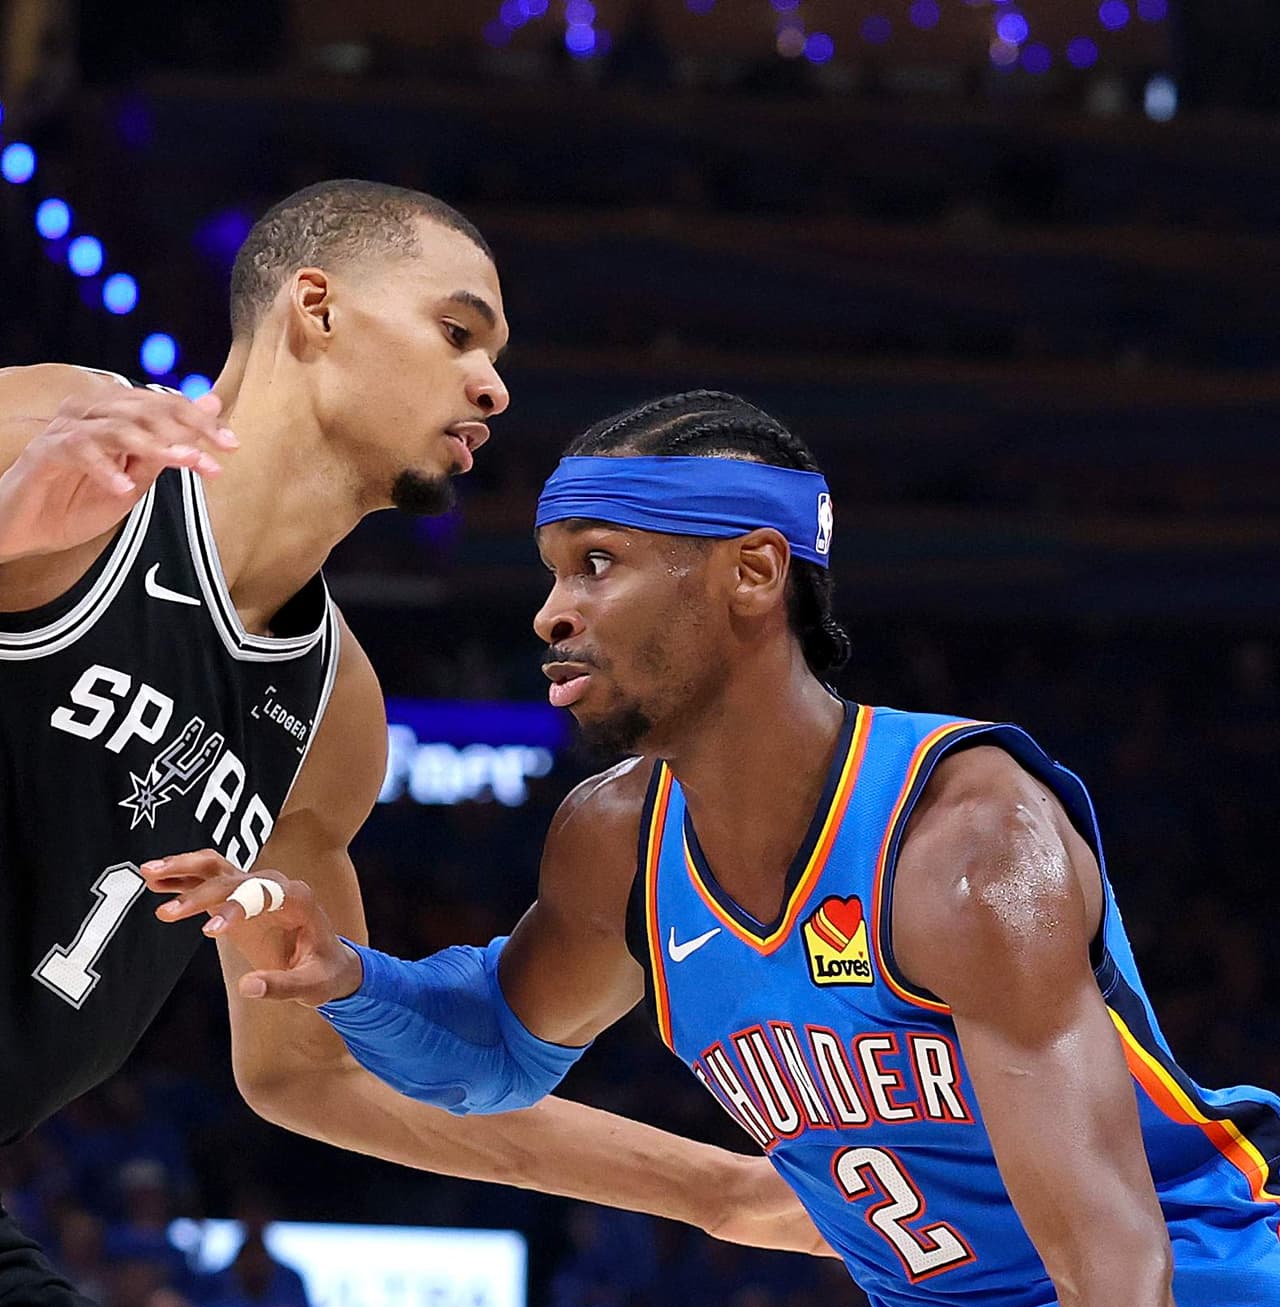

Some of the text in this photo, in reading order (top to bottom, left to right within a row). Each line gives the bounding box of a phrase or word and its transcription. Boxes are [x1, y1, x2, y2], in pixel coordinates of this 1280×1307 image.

[263, 698, 307, 741] LEDGER
[32, 861, 148, 1010] 1
[831, 1146, 977, 1284] 2
